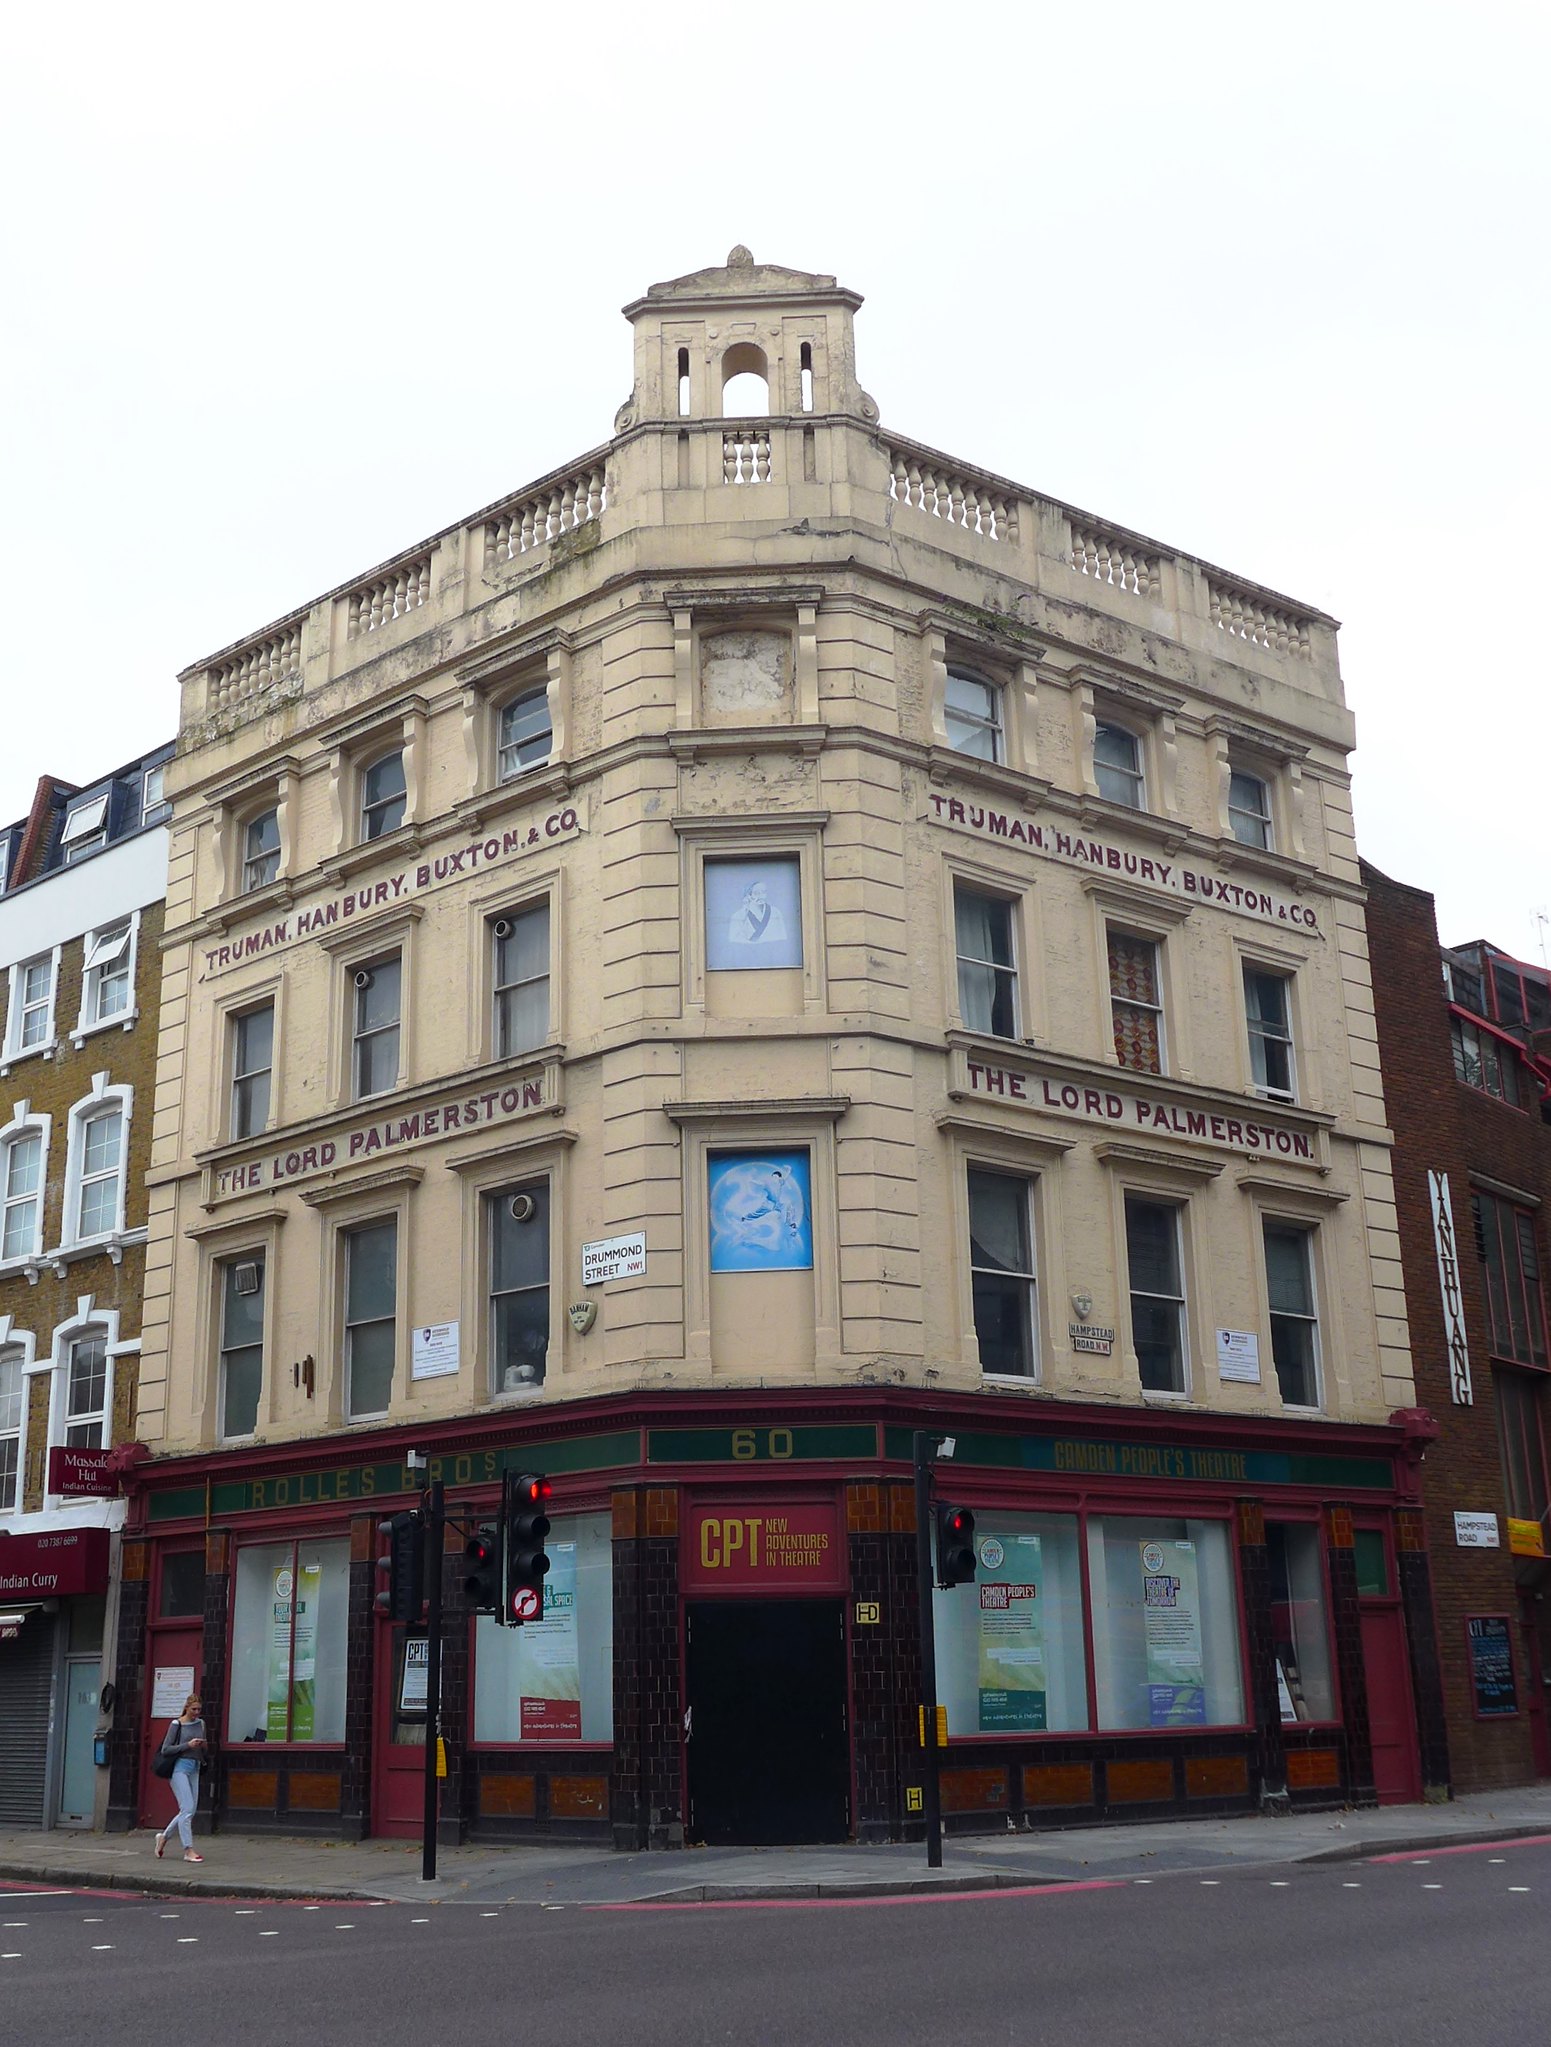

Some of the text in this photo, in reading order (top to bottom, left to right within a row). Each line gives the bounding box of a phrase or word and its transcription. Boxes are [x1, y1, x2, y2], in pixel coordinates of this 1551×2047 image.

[527, 827, 540, 844] &
[1183, 871, 1274, 916] BUXTON
[1278, 905, 1288, 919] &
[967, 1063, 1315, 1160] THE LORD PALMERSTON.
[217, 1162, 262, 1195] THE
[272, 1141, 337, 1180] LORD
[585, 1244, 642, 1266] DRUMMOND
[585, 1261, 643, 1280] STREET NW1
[1433, 1172, 1470, 1405] YANHUANG
[1070, 1323, 1113, 1339] HAMPSTEAD
[731, 1428, 793, 1460] 60
[1054, 1441, 1248, 1480] CAMDEN PEOPLE'S THEATRE
[78, 1469, 97, 1481] Hut
[62, 1481, 112, 1493] Indian Cuisine
[252, 1467, 375, 1508] ROLLES
[765, 1518, 788, 1533] NEW
[1456, 1521, 1497, 1532] HAMPSTEAD
[700, 1518, 763, 1568] CPT
[765, 1533, 829, 1550] ADVENTURES
[1458, 1533, 1478, 1543] ROAD
[765, 1550, 821, 1567] IN THEATRE
[0, 1572, 58, 1590] Indian Curry
[408, 1642, 425, 1660] CPT
[909, 1790, 921, 1809] H
